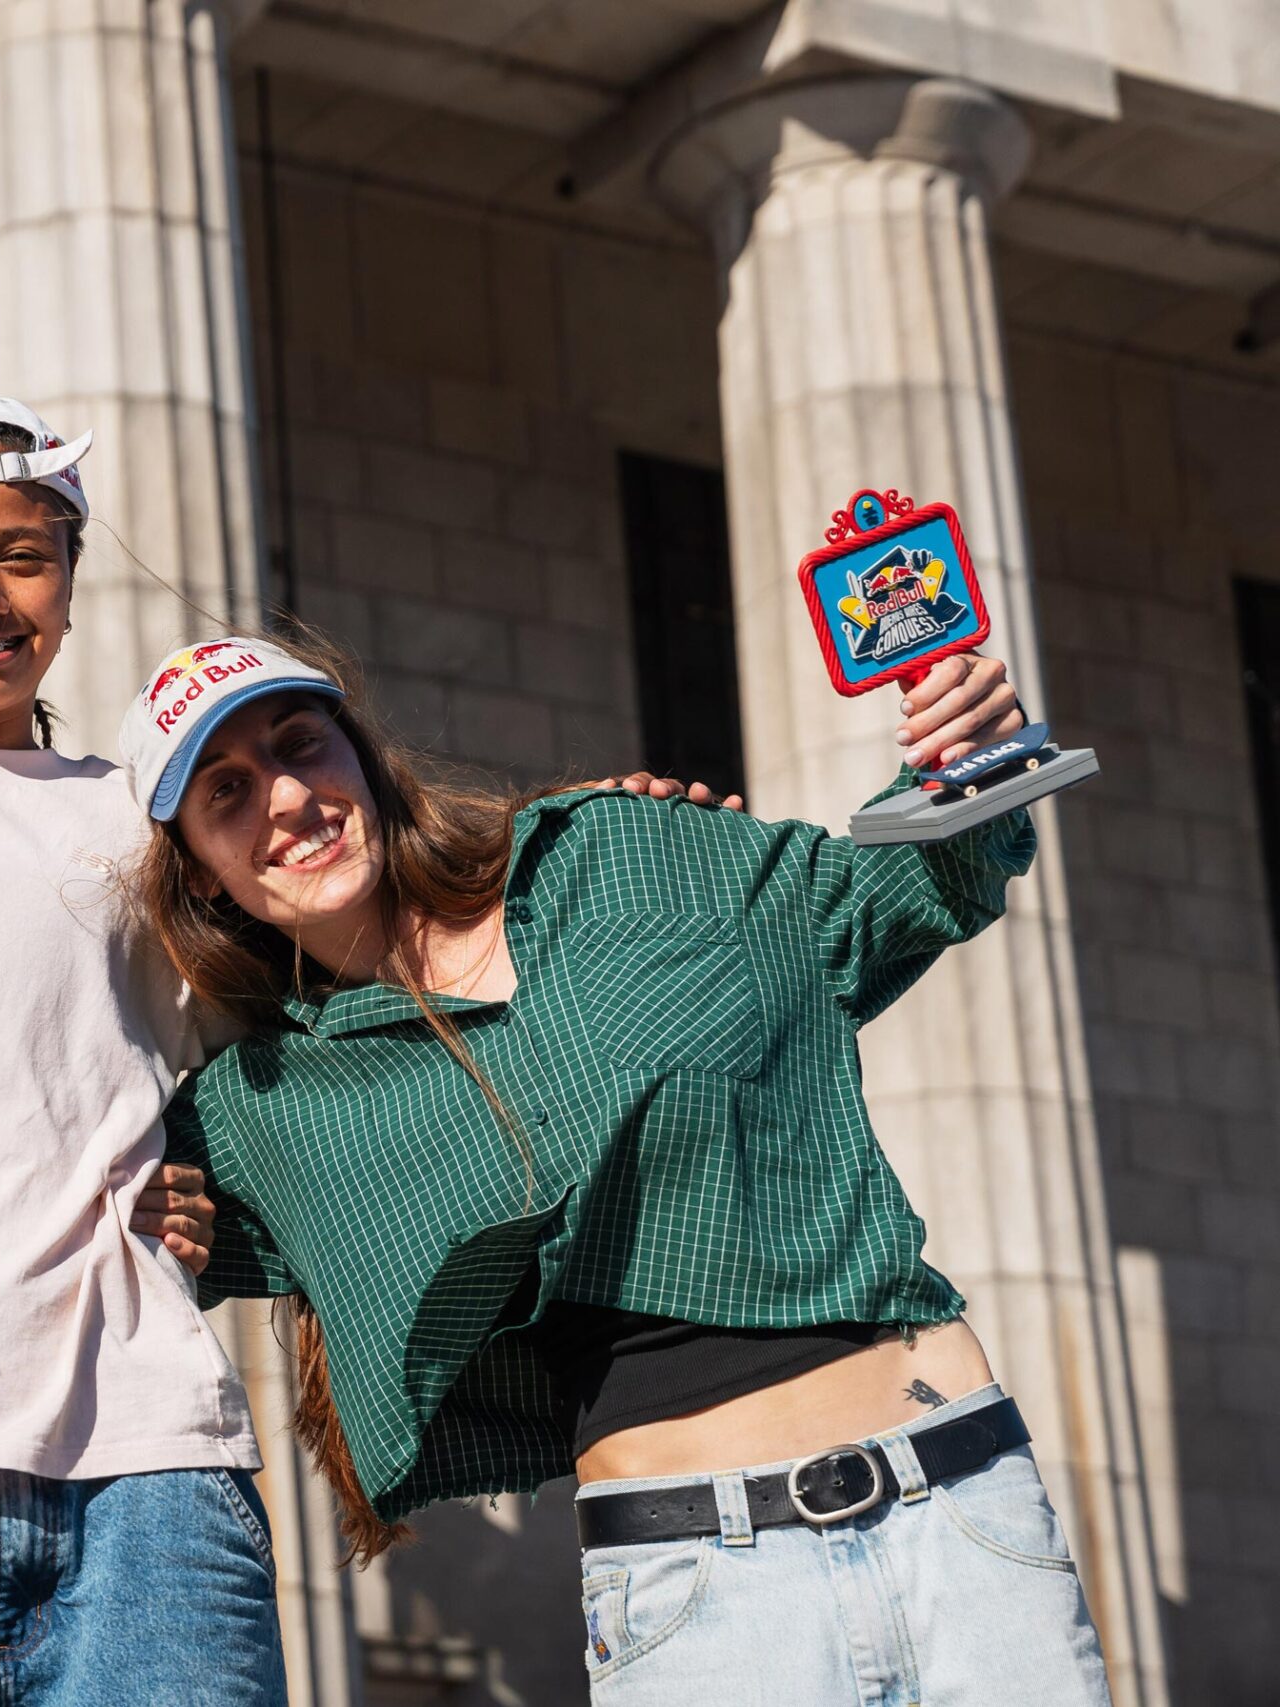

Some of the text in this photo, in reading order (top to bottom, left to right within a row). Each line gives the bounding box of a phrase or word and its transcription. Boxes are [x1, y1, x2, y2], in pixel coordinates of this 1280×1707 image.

[866, 591, 897, 619] Red
[896, 580, 927, 607] Bull
[875, 616, 941, 656] CONQUEST
[155, 653, 264, 735] Red Bull
